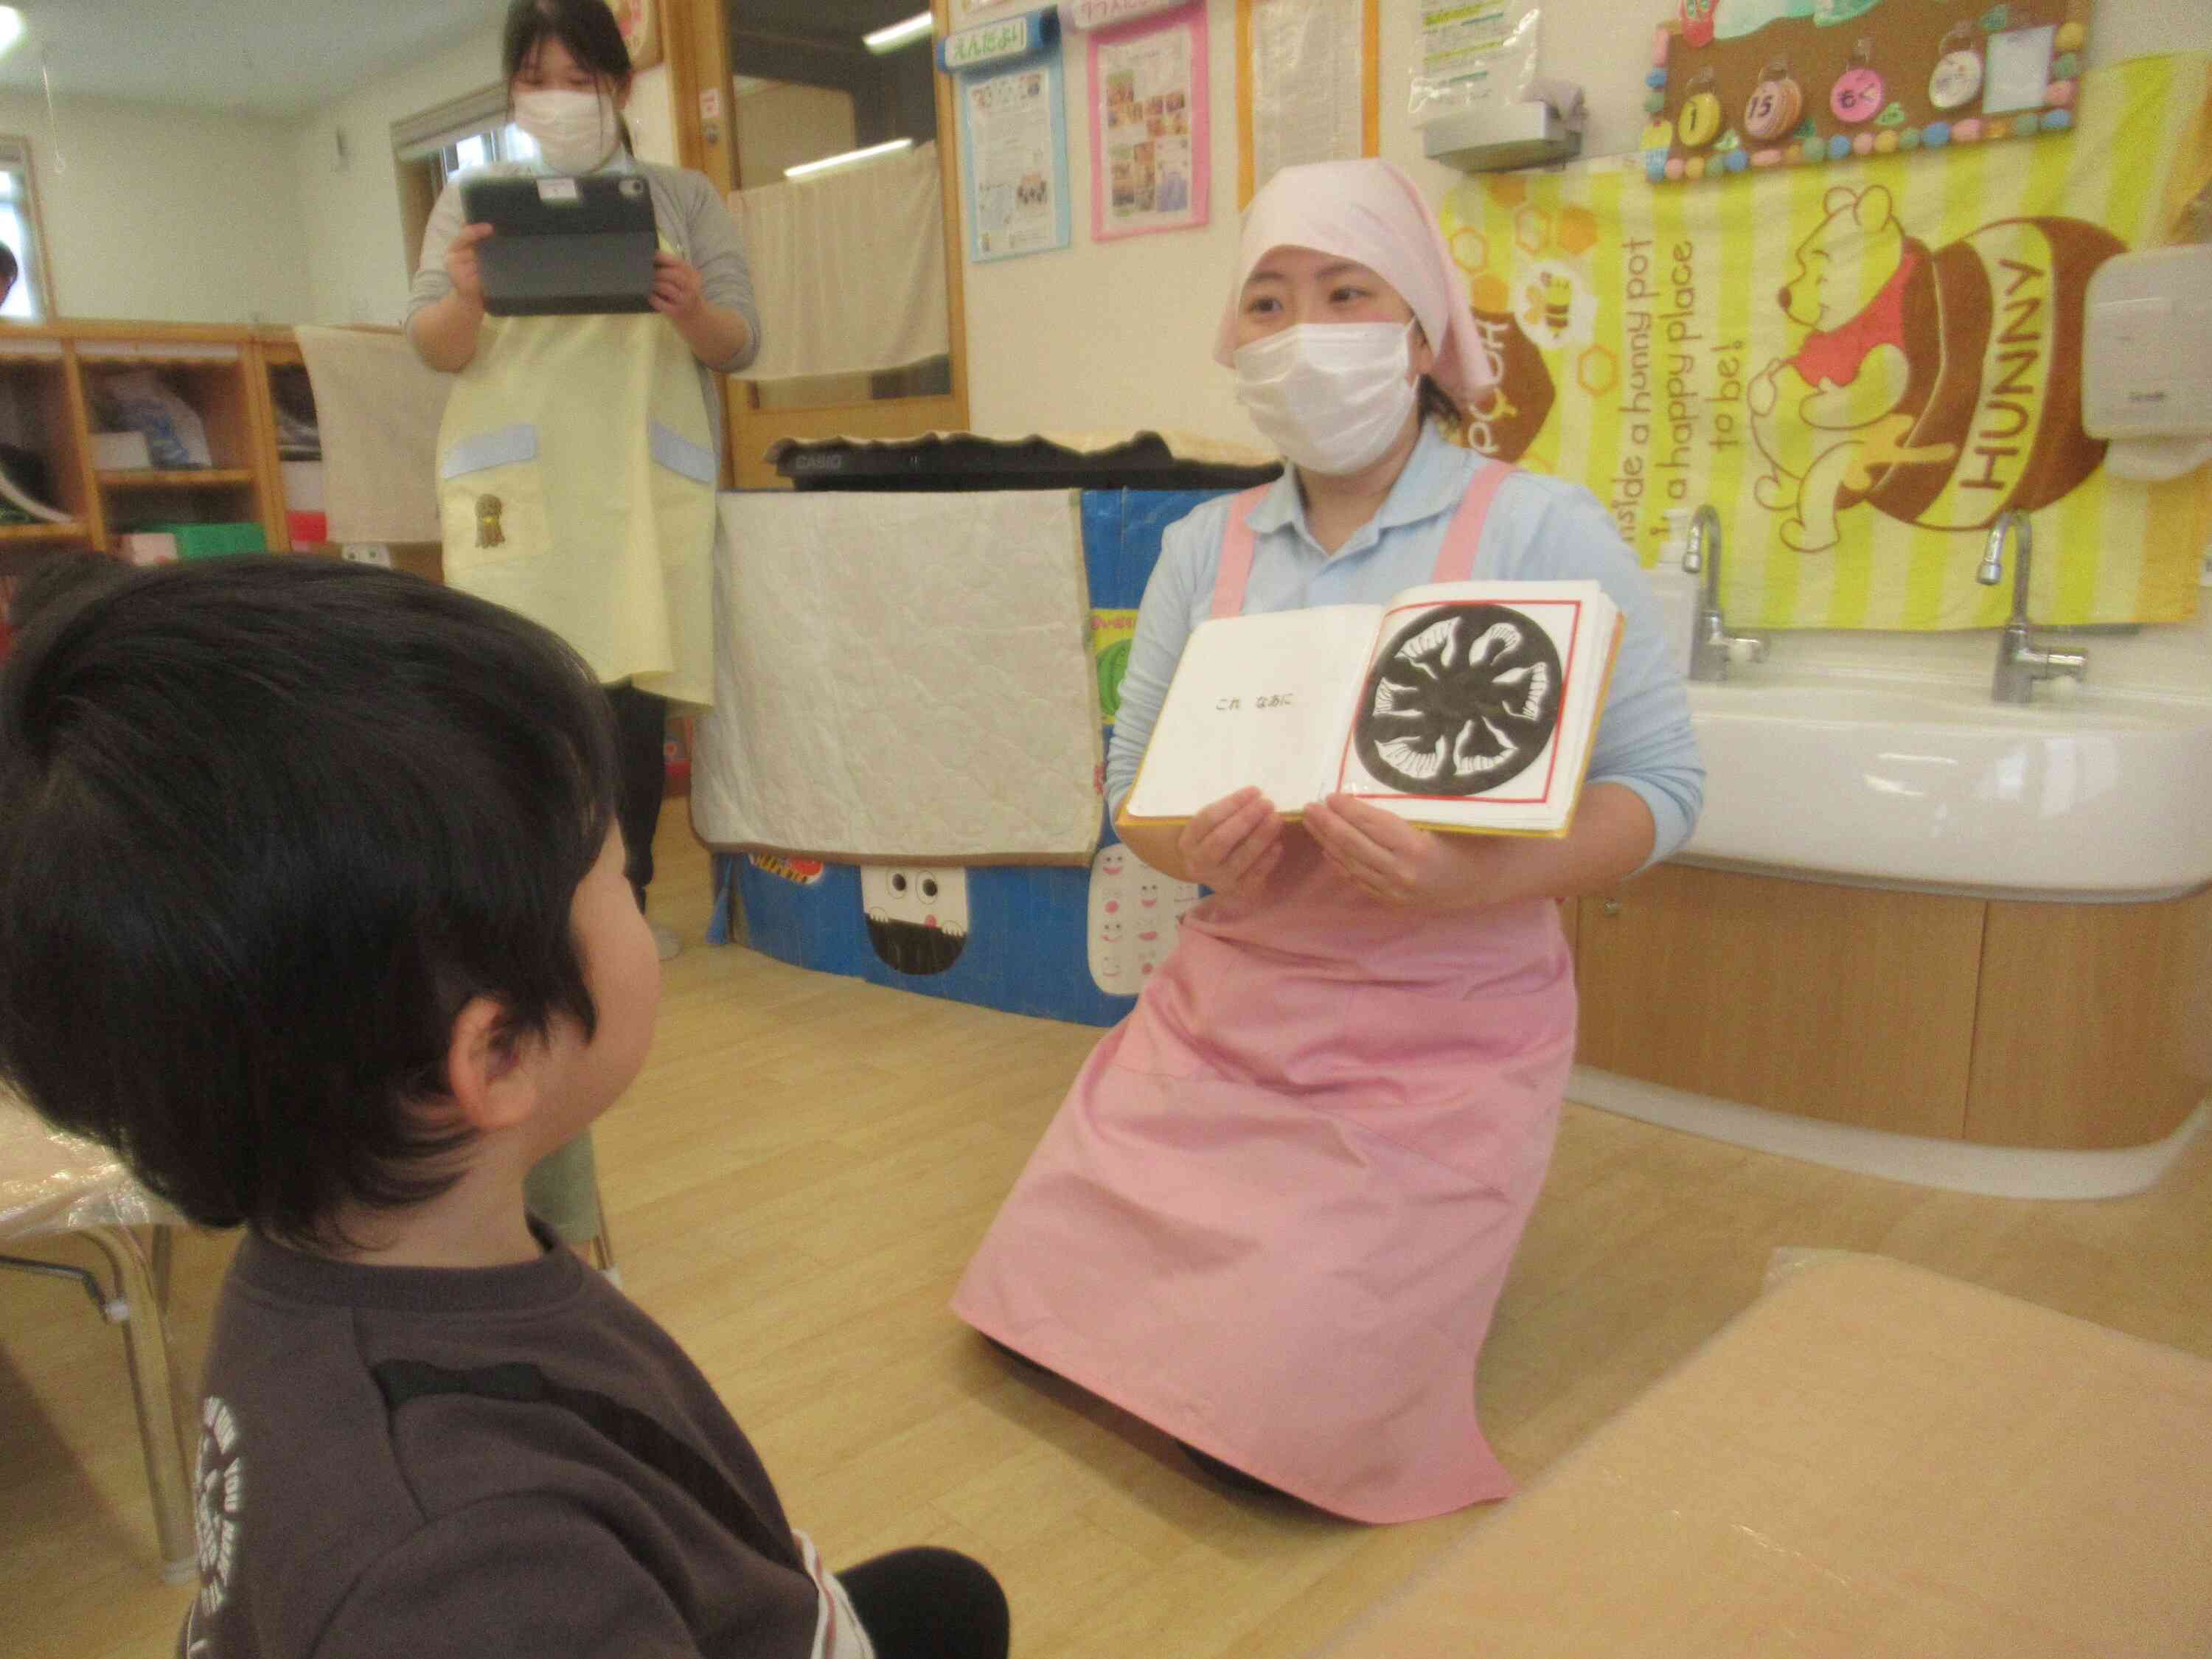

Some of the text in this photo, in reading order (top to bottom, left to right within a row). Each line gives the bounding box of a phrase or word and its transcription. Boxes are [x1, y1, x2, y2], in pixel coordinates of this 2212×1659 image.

[1658, 241, 1703, 342] place
[1610, 237, 1660, 543] nside a hunny pot
[1655, 354, 1699, 469] happy
[1704, 340, 1744, 451] to be!
[1958, 259, 2044, 490] HUNNY
[796, 453, 842, 470] CASIO
[1667, 479, 1687, 499] a
